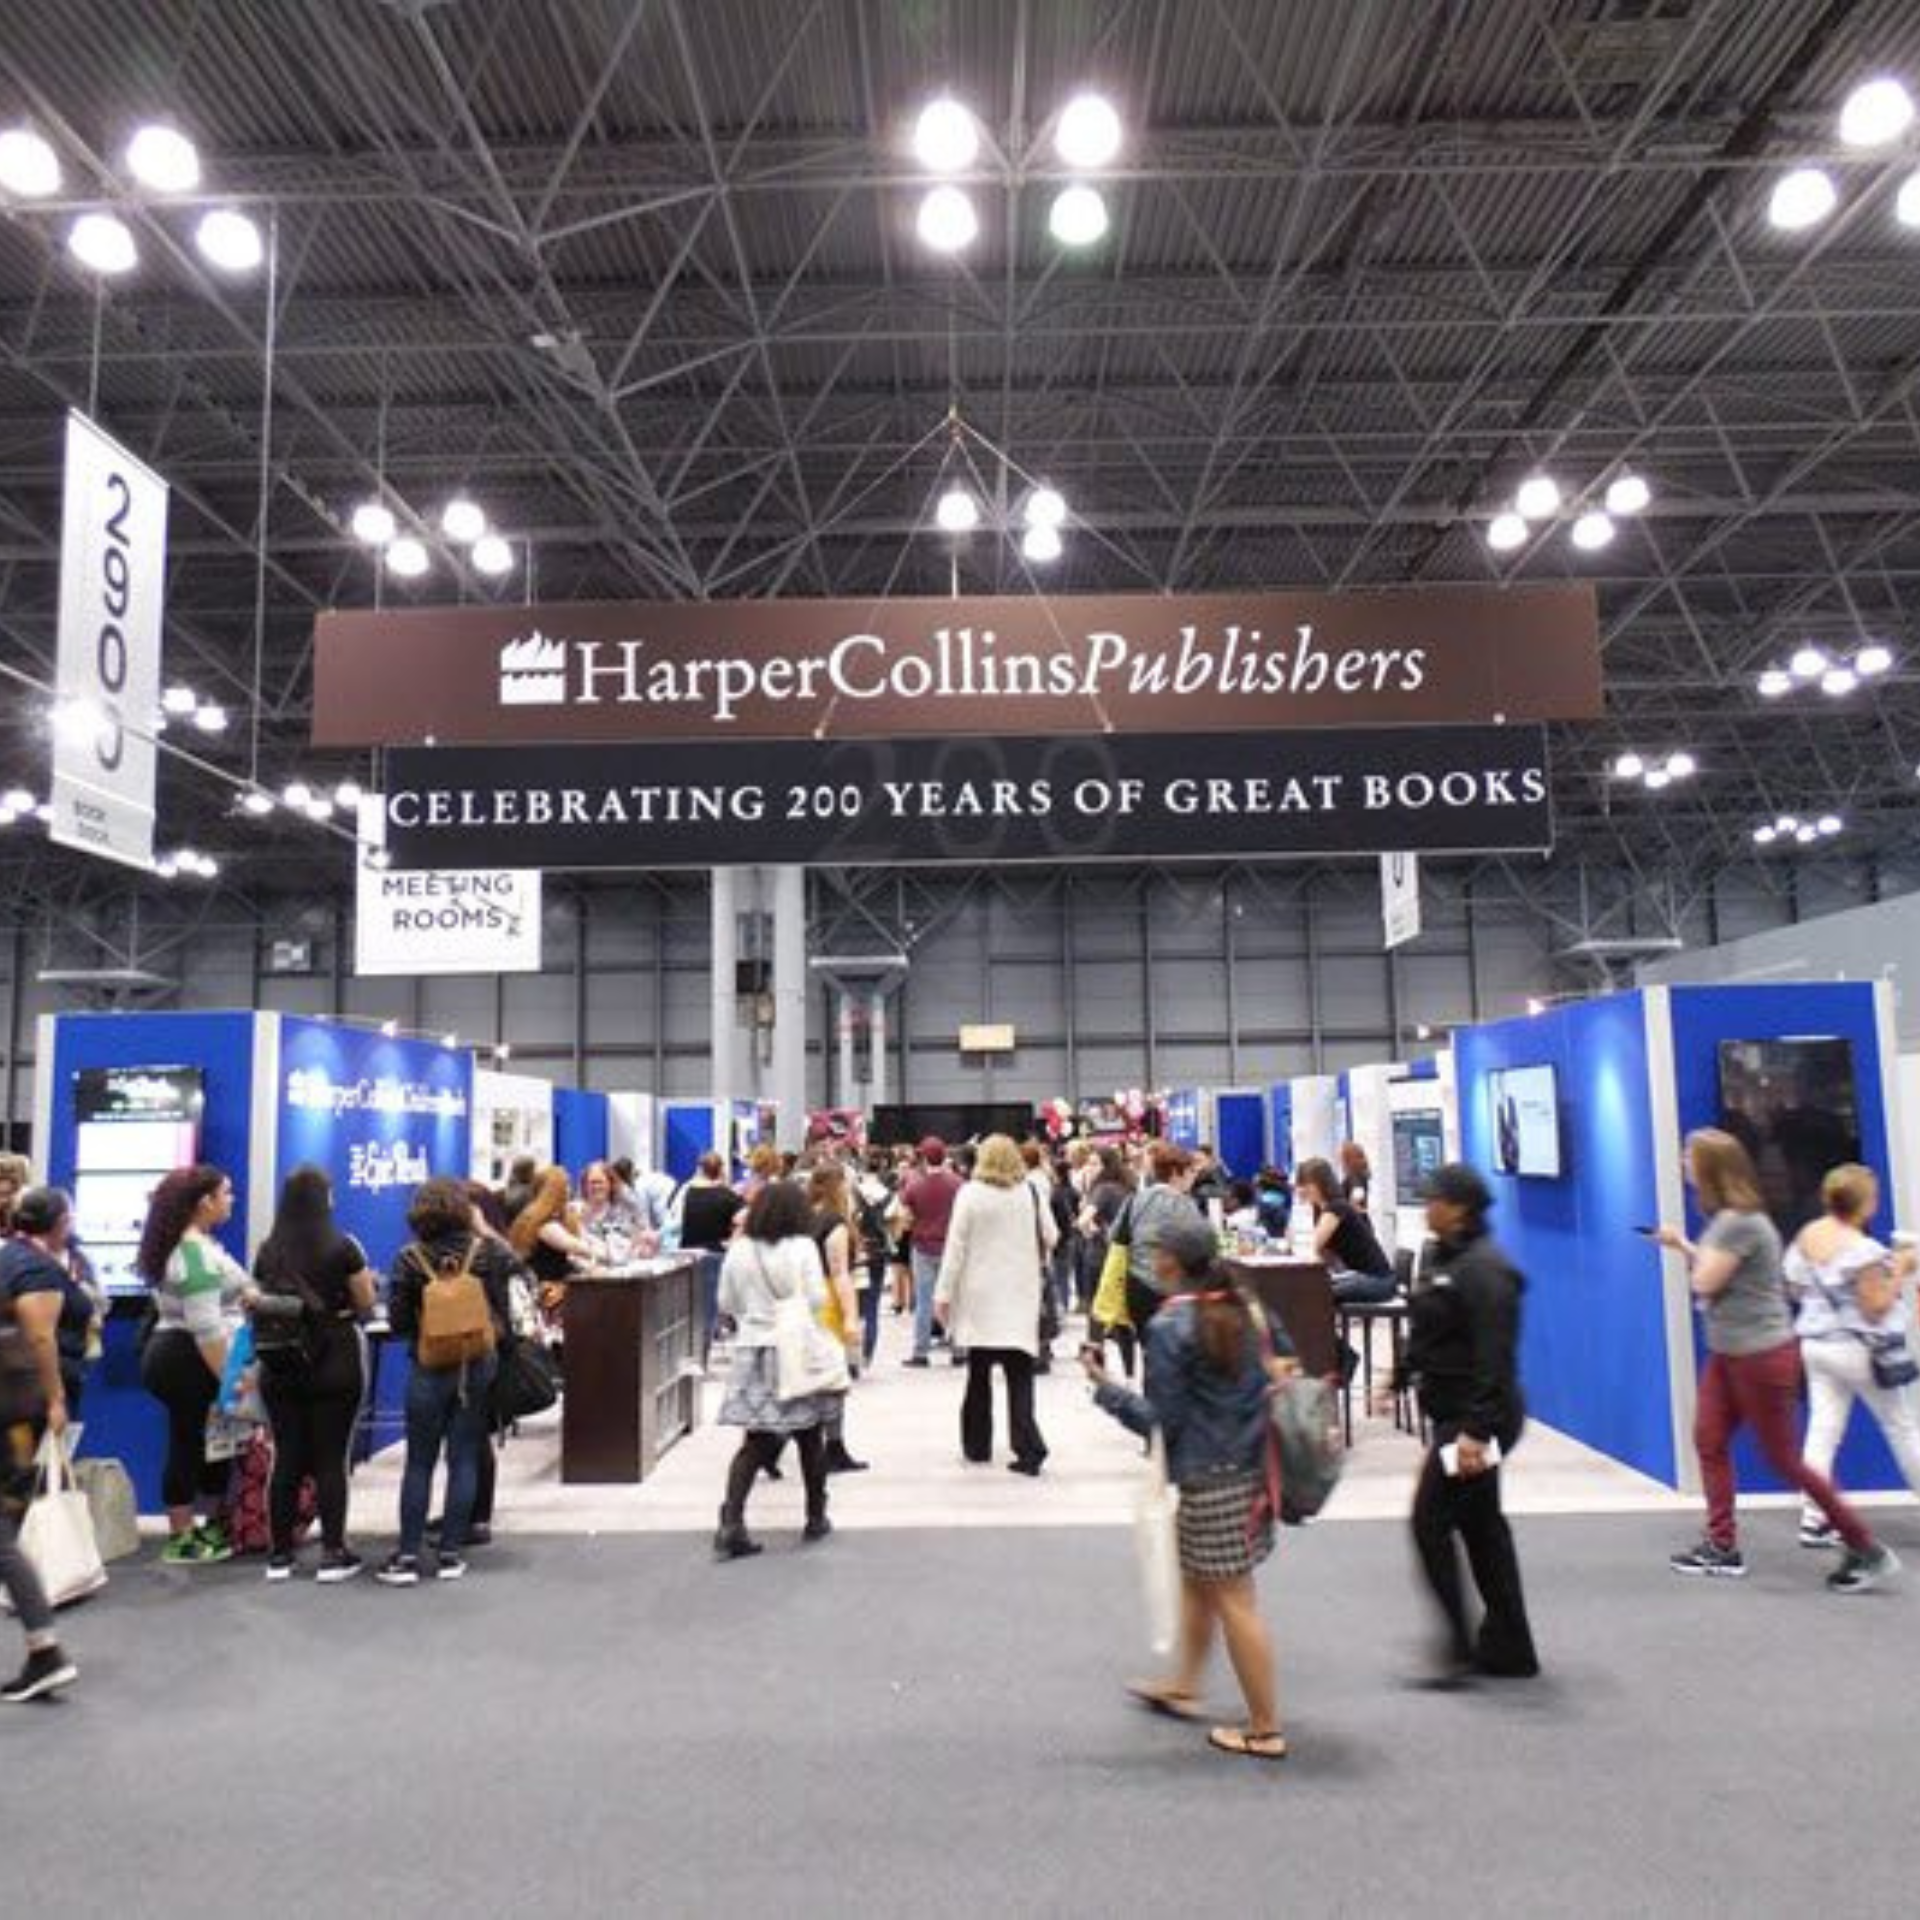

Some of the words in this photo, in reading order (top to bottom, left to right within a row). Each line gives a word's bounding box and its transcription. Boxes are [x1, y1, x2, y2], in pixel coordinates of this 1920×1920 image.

[577, 625, 1424, 721] HarperCollinsPublishers
[387, 785, 766, 827] CELEBRATING
[786, 784, 862, 819] 200
[882, 779, 1052, 816] YEARS
[1073, 779, 1144, 814] OF
[1163, 775, 1342, 814] GREAT
[1363, 768, 1546, 809] BOOKS
[382, 873, 513, 896] MEETING
[392, 906, 502, 931] ROOMS
